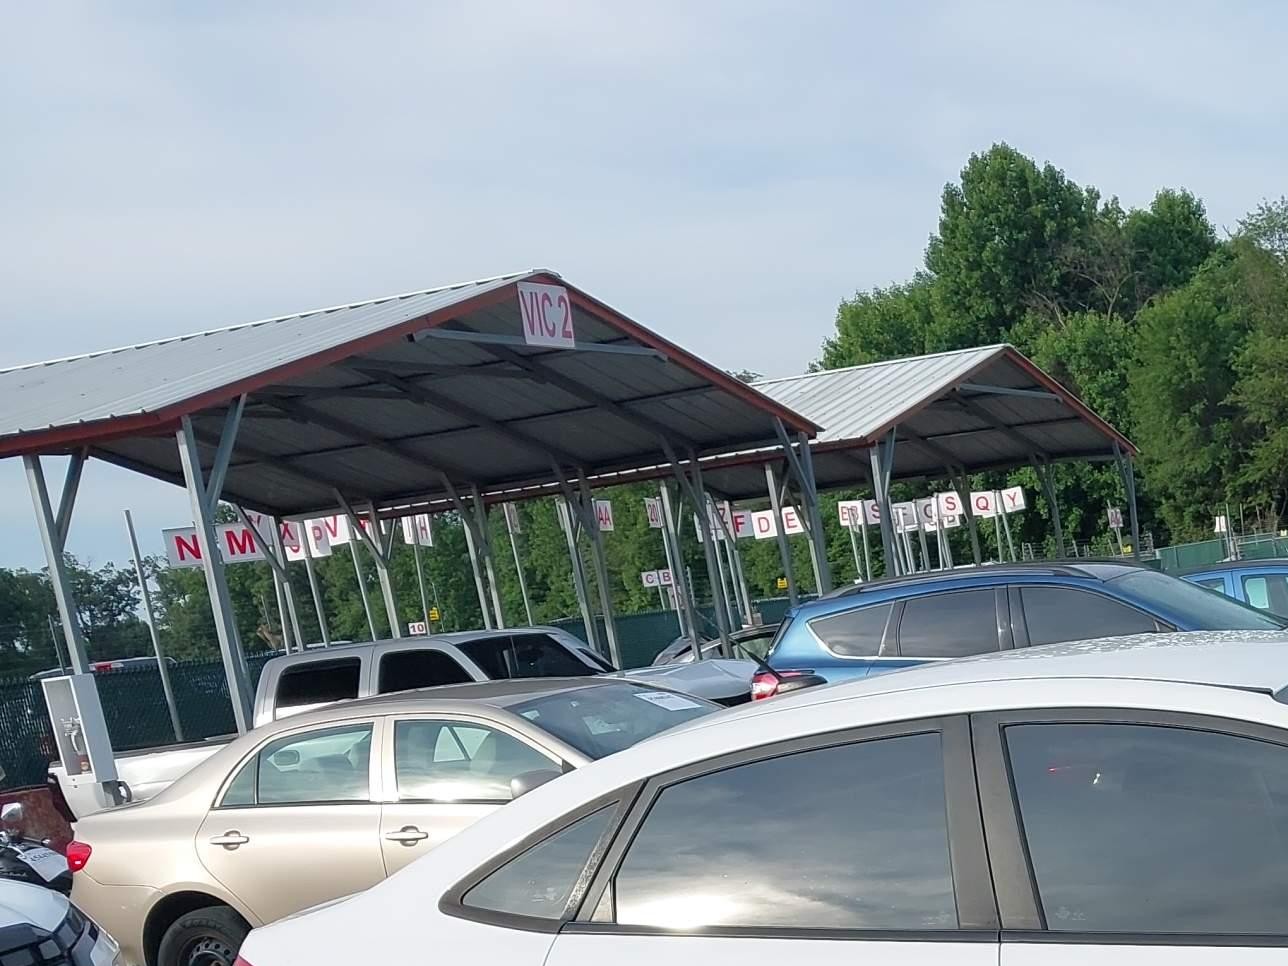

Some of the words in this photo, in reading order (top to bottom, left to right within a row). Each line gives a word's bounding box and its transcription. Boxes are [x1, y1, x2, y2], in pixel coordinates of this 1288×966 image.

[520, 291, 556, 337] VIC
[558, 295, 573, 338] 2
[945, 496, 956, 511] S
[975, 496, 989, 511] Q
[1008, 492, 1017, 507] Y
[734, 515, 745, 533] F
[758, 517, 770, 533] D
[784, 512, 798, 529] E
[175, 534, 202, 561] N
[225, 529, 256, 555] M
[645, 574, 655, 584] C
[662, 572, 671, 582] B
